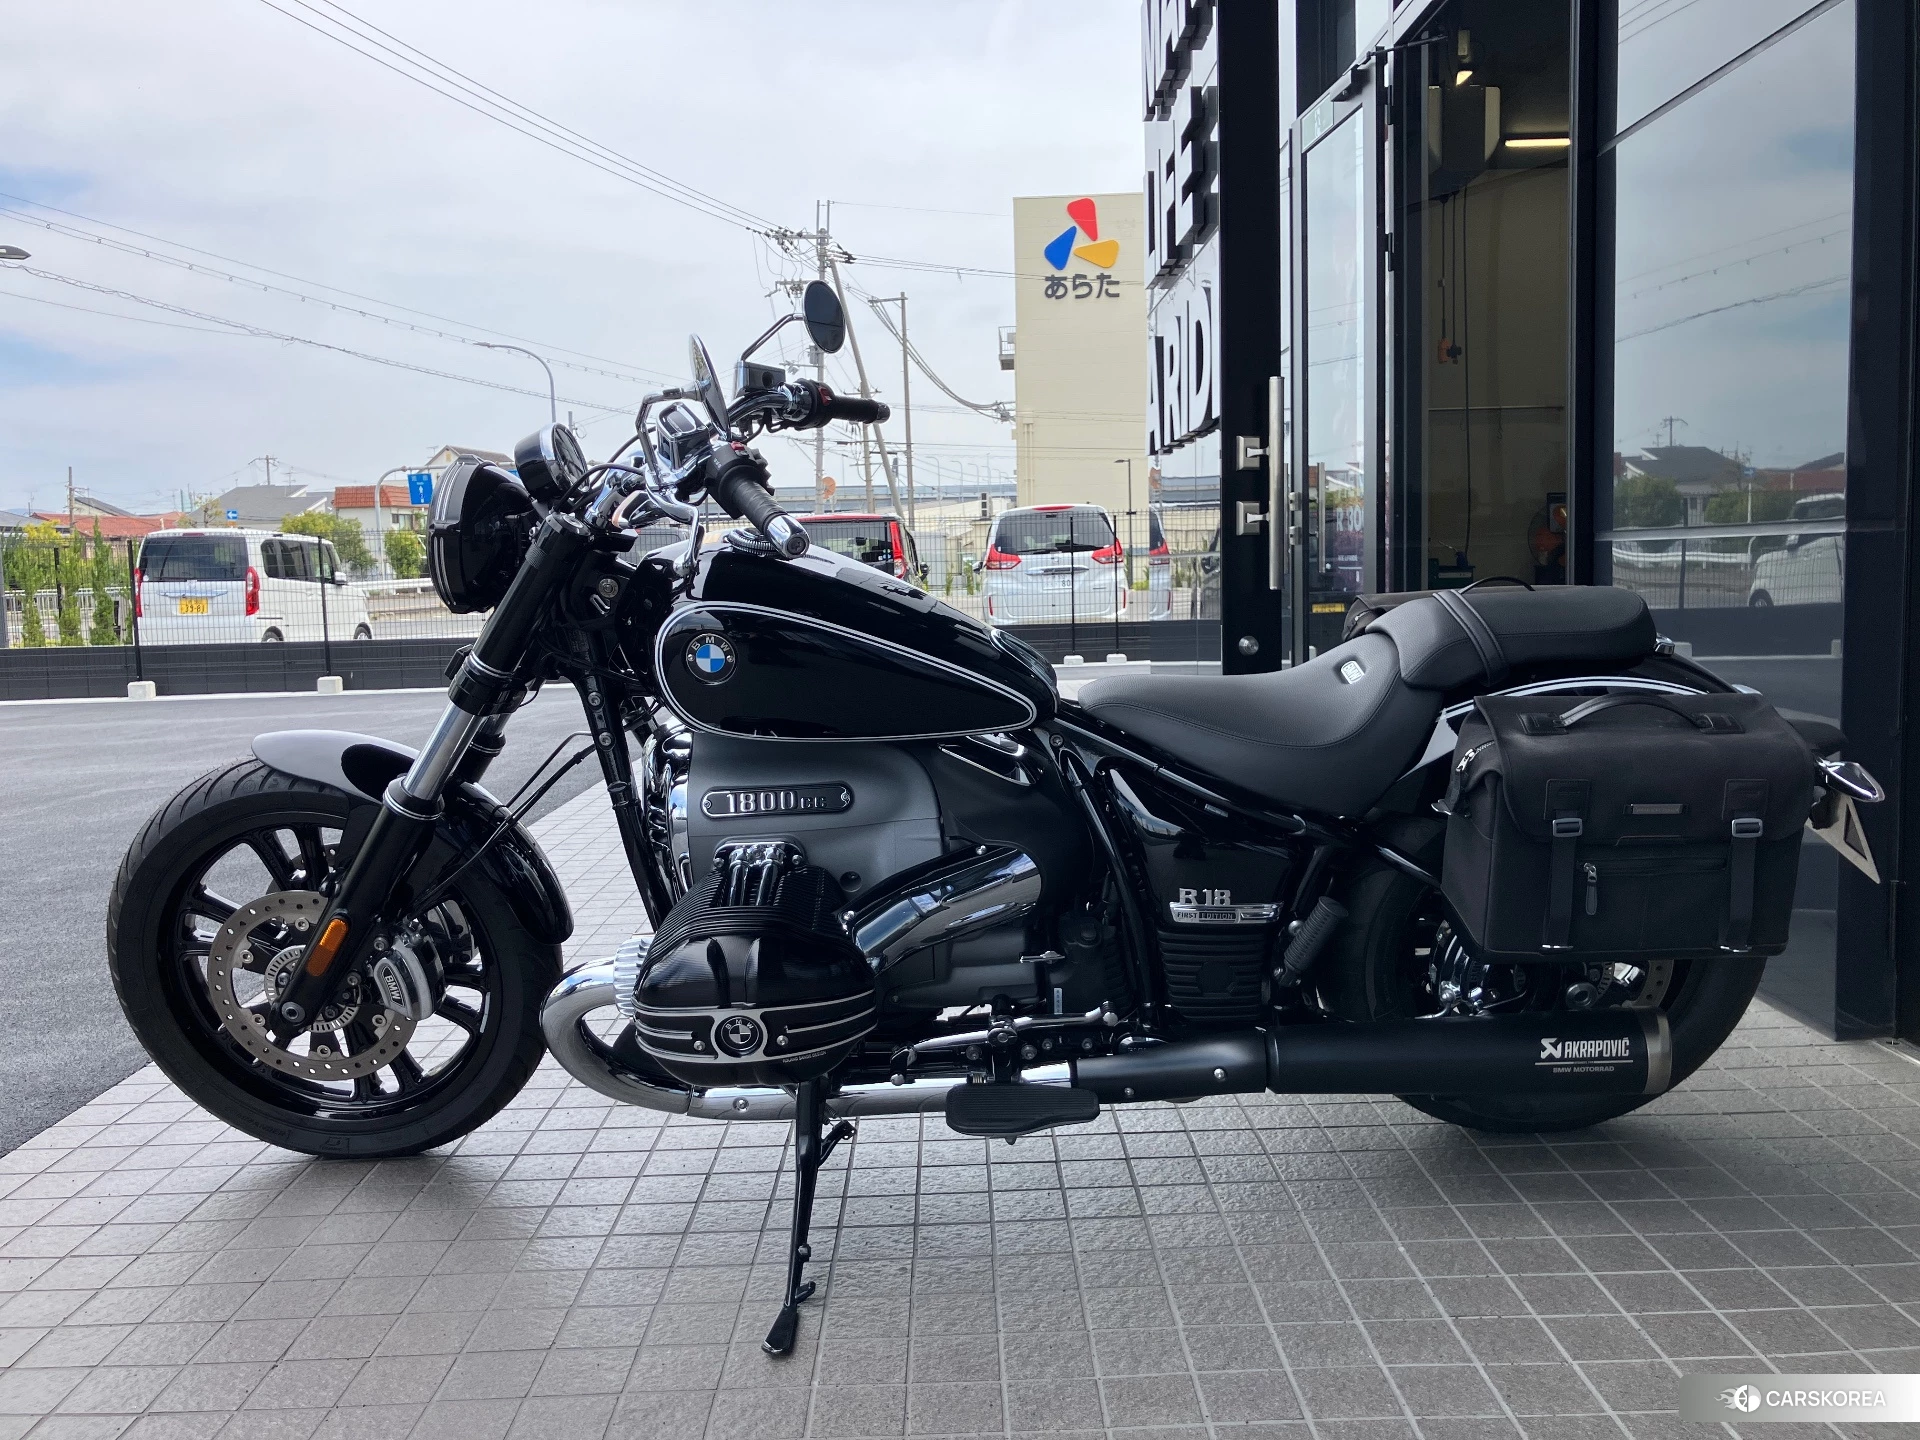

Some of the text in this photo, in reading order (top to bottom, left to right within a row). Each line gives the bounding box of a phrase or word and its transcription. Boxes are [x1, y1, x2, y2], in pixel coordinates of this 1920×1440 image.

[1044, 273, 1120, 299] あらた
[691, 636, 730, 652] BMW
[1178, 888, 1231, 906] R 18
[1177, 911, 1234, 920] FIRST EDITION
[384, 975, 401, 1000] BMW
[725, 1019, 754, 1031] BMW
[1552, 1065, 1615, 1074] BMW MOTORRAD
